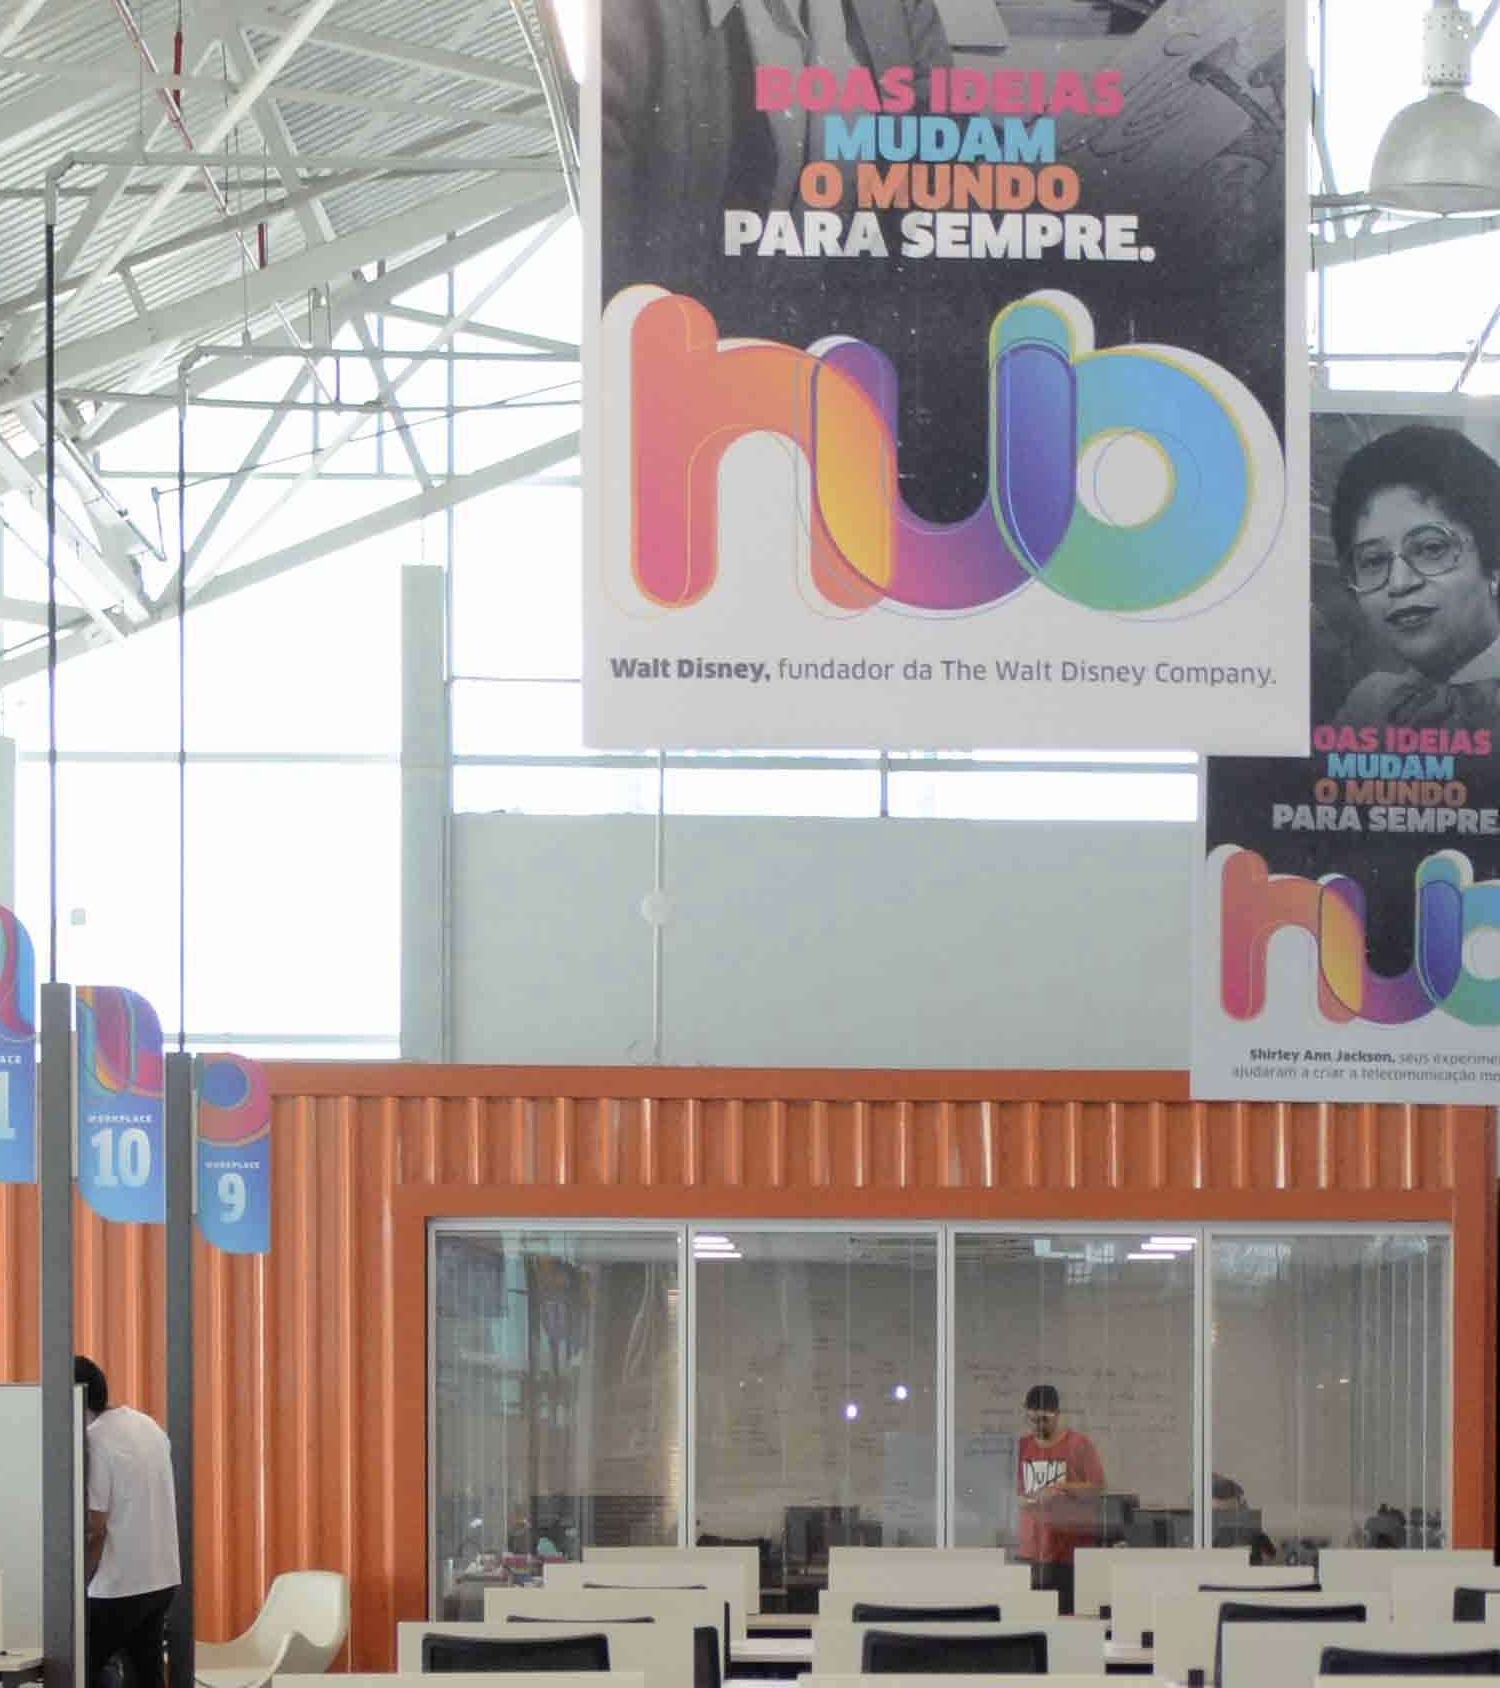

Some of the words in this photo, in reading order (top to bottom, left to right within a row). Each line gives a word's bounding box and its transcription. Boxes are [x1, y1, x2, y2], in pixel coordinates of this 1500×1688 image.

[755, 66, 915, 113] BOAS
[930, 67, 1125, 117] IDEIAS
[824, 114, 1056, 163] MUDAM
[800, 163, 843, 209] O
[857, 164, 1081, 211] MUNDO
[724, 210, 889, 257] PARA
[901, 212, 1157, 262] SEMPRE.
[611, 658, 671, 679] Walt
[676, 658, 771, 683] Disney,
[778, 658, 895, 681] fundador
[902, 659, 934, 681] da
[940, 660, 988, 682] The
[996, 660, 1052, 682] Walt
[1061, 660, 1147, 686] Disney
[1155, 661, 1277, 687] Company.
[1314, 725, 1379, 752] OAS
[1385, 727, 1493, 755] IDEIAS
[1327, 753, 1455, 779] MUDAM
[1315, 778, 1339, 803] O
[1346, 779, 1468, 806] MUNDO
[1272, 804, 1362, 832] PARA
[1250, 1048, 1299, 1063] Shirley
[1303, 1049, 1331, 1061] Ann
[1336, 1050, 1396, 1063] Jackson,
[87, 1114, 153, 1124] WORKPLACE
[91, 1127, 152, 1188] 10
[217, 1173, 247, 1223] 9
